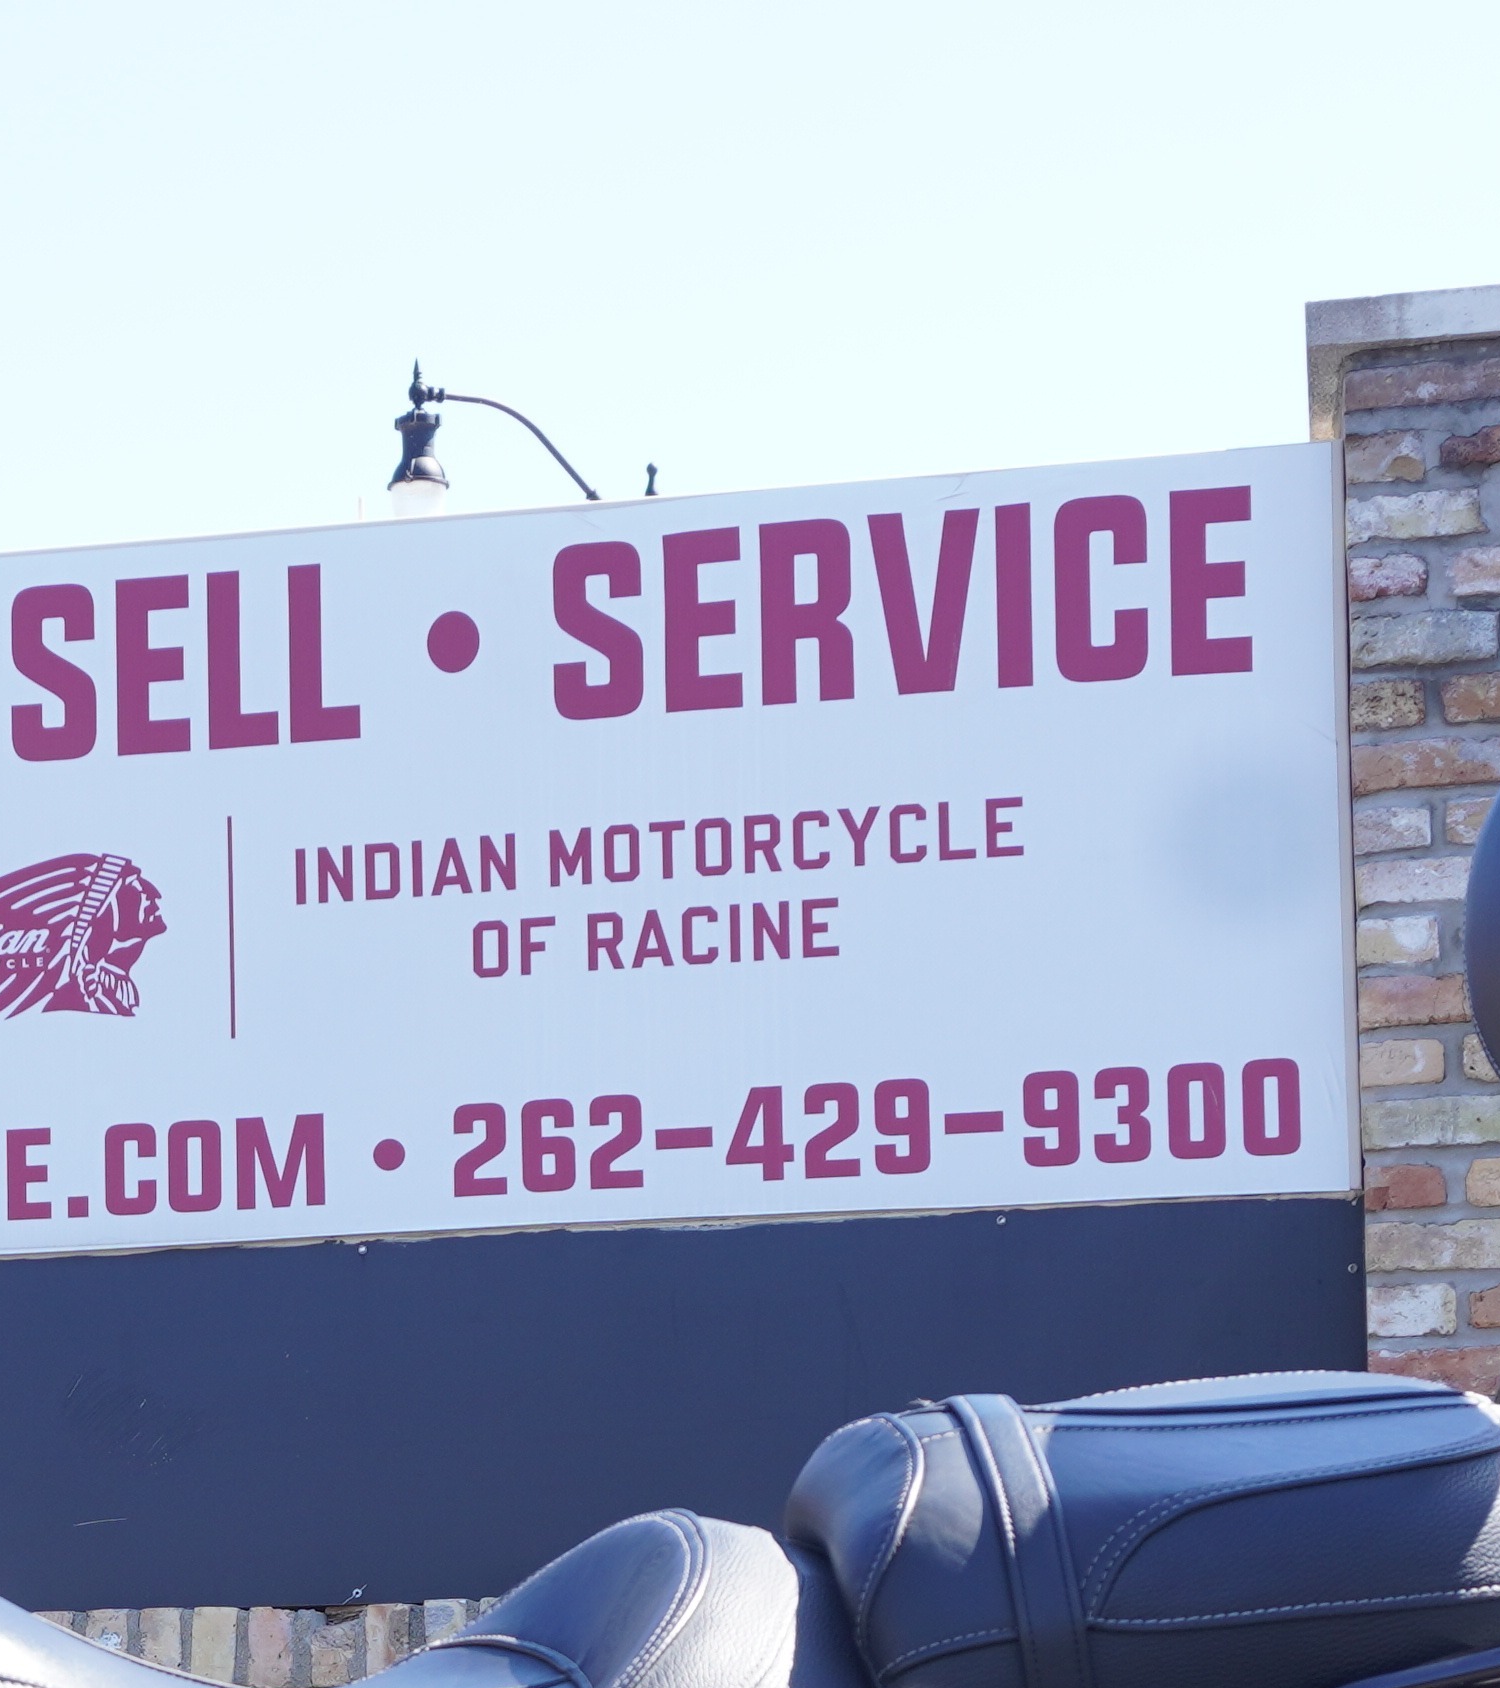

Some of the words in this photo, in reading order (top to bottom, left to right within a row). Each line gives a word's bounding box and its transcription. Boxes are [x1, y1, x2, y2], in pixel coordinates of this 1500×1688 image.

[10, 563, 362, 763] SELL
[551, 485, 1254, 721] SERVICE
[294, 839, 517, 906] INDIAN
[549, 796, 1027, 886] MOTORCYCLE
[472, 916, 556, 977] OF
[587, 899, 841, 971] RACINE
[452, 1058, 1302, 1198] 262-429-9300
